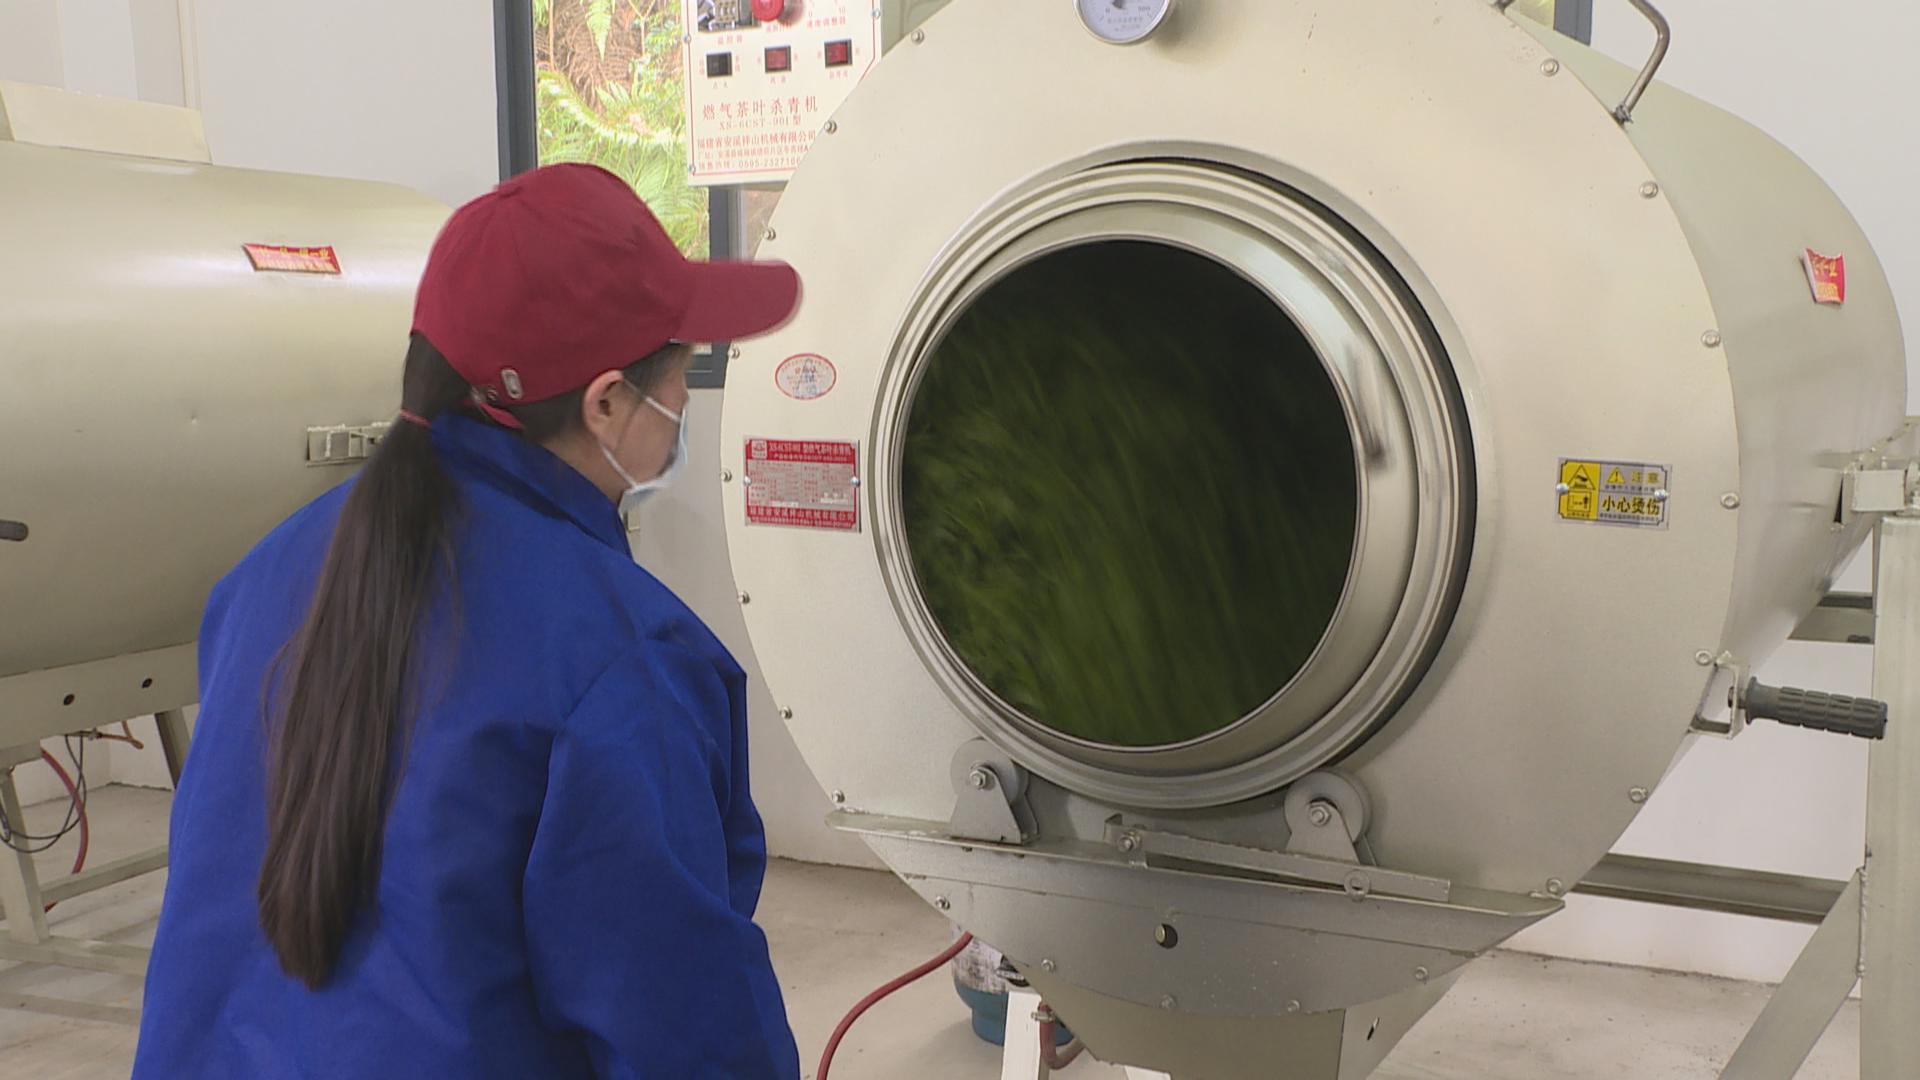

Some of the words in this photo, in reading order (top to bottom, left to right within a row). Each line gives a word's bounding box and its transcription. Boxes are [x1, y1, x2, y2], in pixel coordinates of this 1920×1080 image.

[703, 95, 818, 121] 燃气茶叶杀青机
[1602, 495, 1660, 516] 小心烫伤
